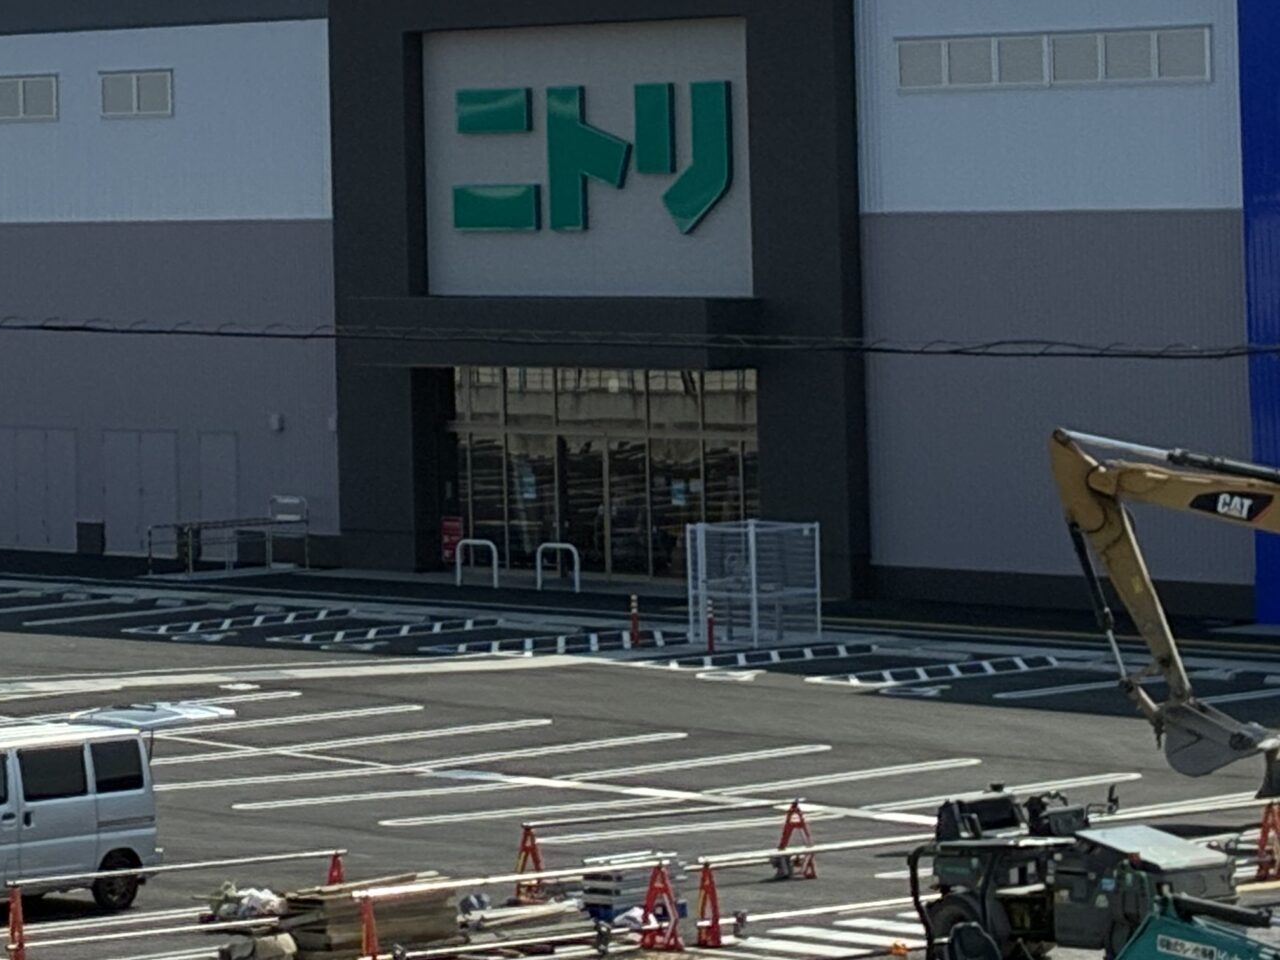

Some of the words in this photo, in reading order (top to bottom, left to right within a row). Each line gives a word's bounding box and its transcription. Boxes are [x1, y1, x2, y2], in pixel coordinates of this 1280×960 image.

[452, 80, 733, 234] ニトリ
[1217, 492, 1253, 519] CAT
